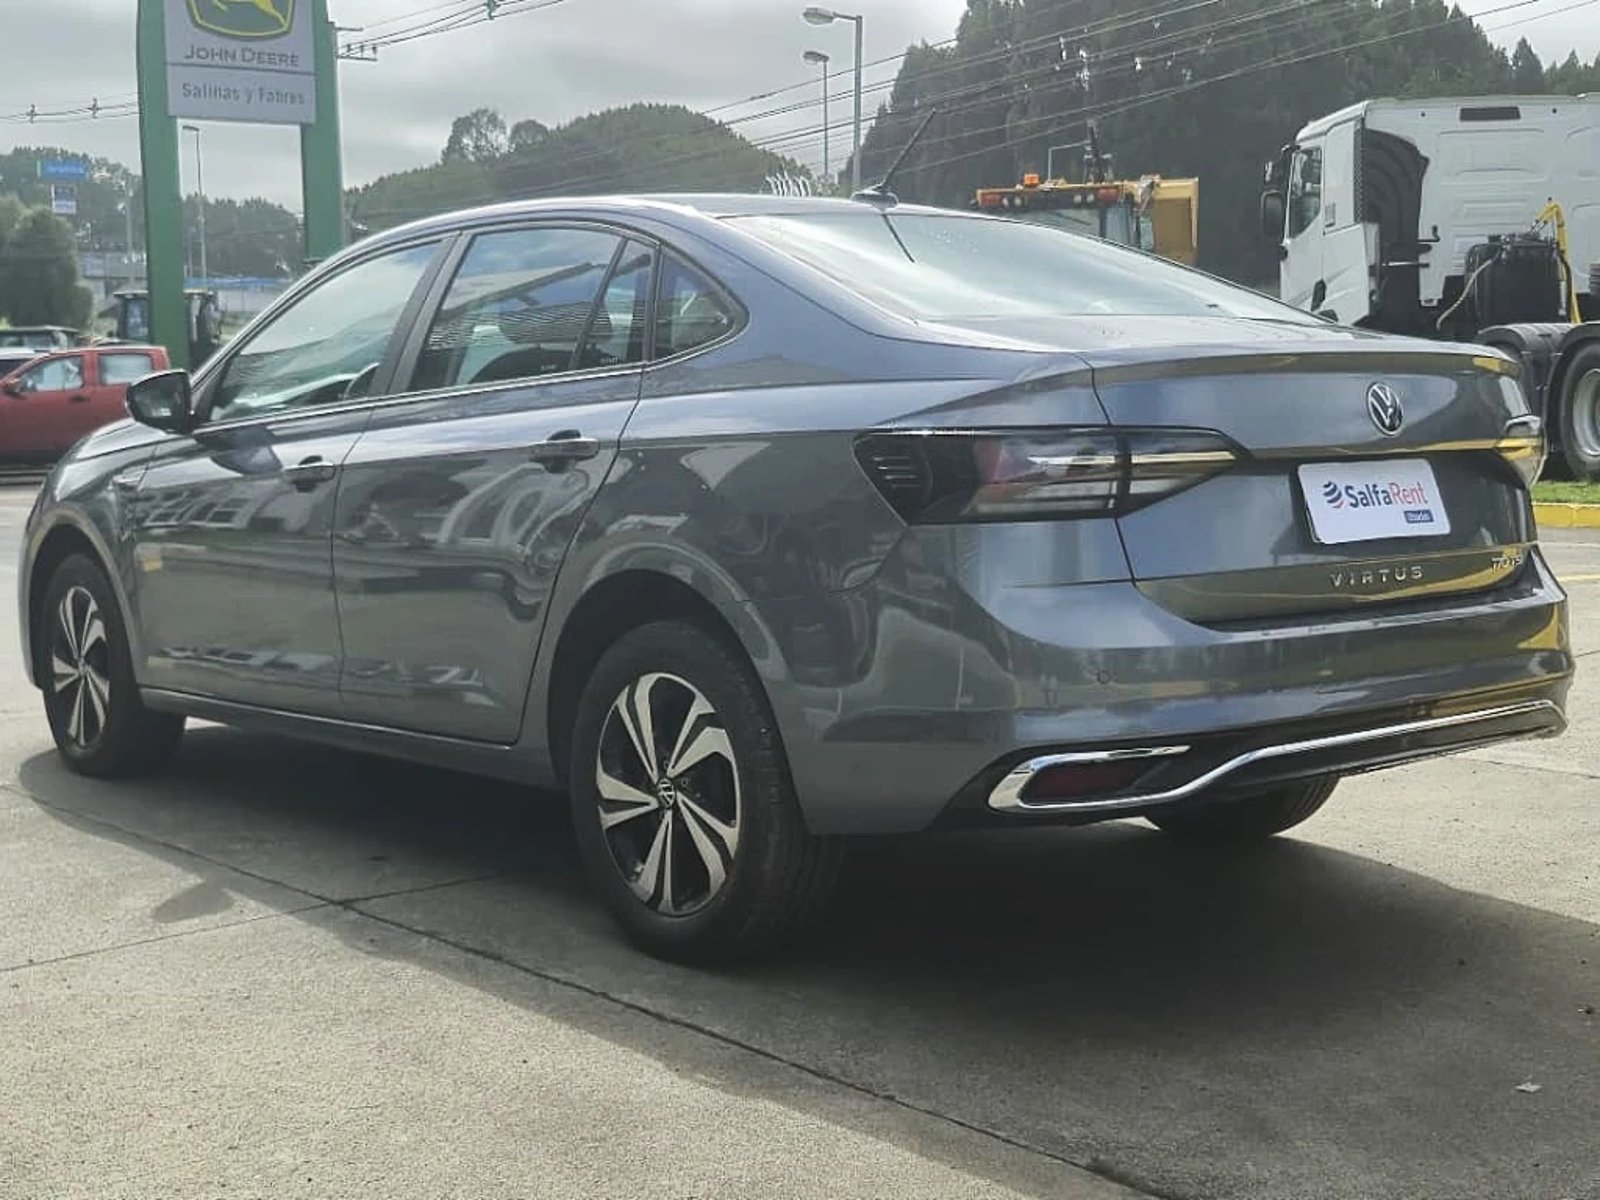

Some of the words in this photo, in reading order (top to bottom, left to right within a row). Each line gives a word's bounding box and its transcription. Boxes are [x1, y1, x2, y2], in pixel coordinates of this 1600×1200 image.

[184, 44, 236, 63] JOHN
[241, 47, 299, 67] DEERE
[1344, 482, 1428, 508] SalfaRent
[1330, 566, 1422, 587] VIRTUS
